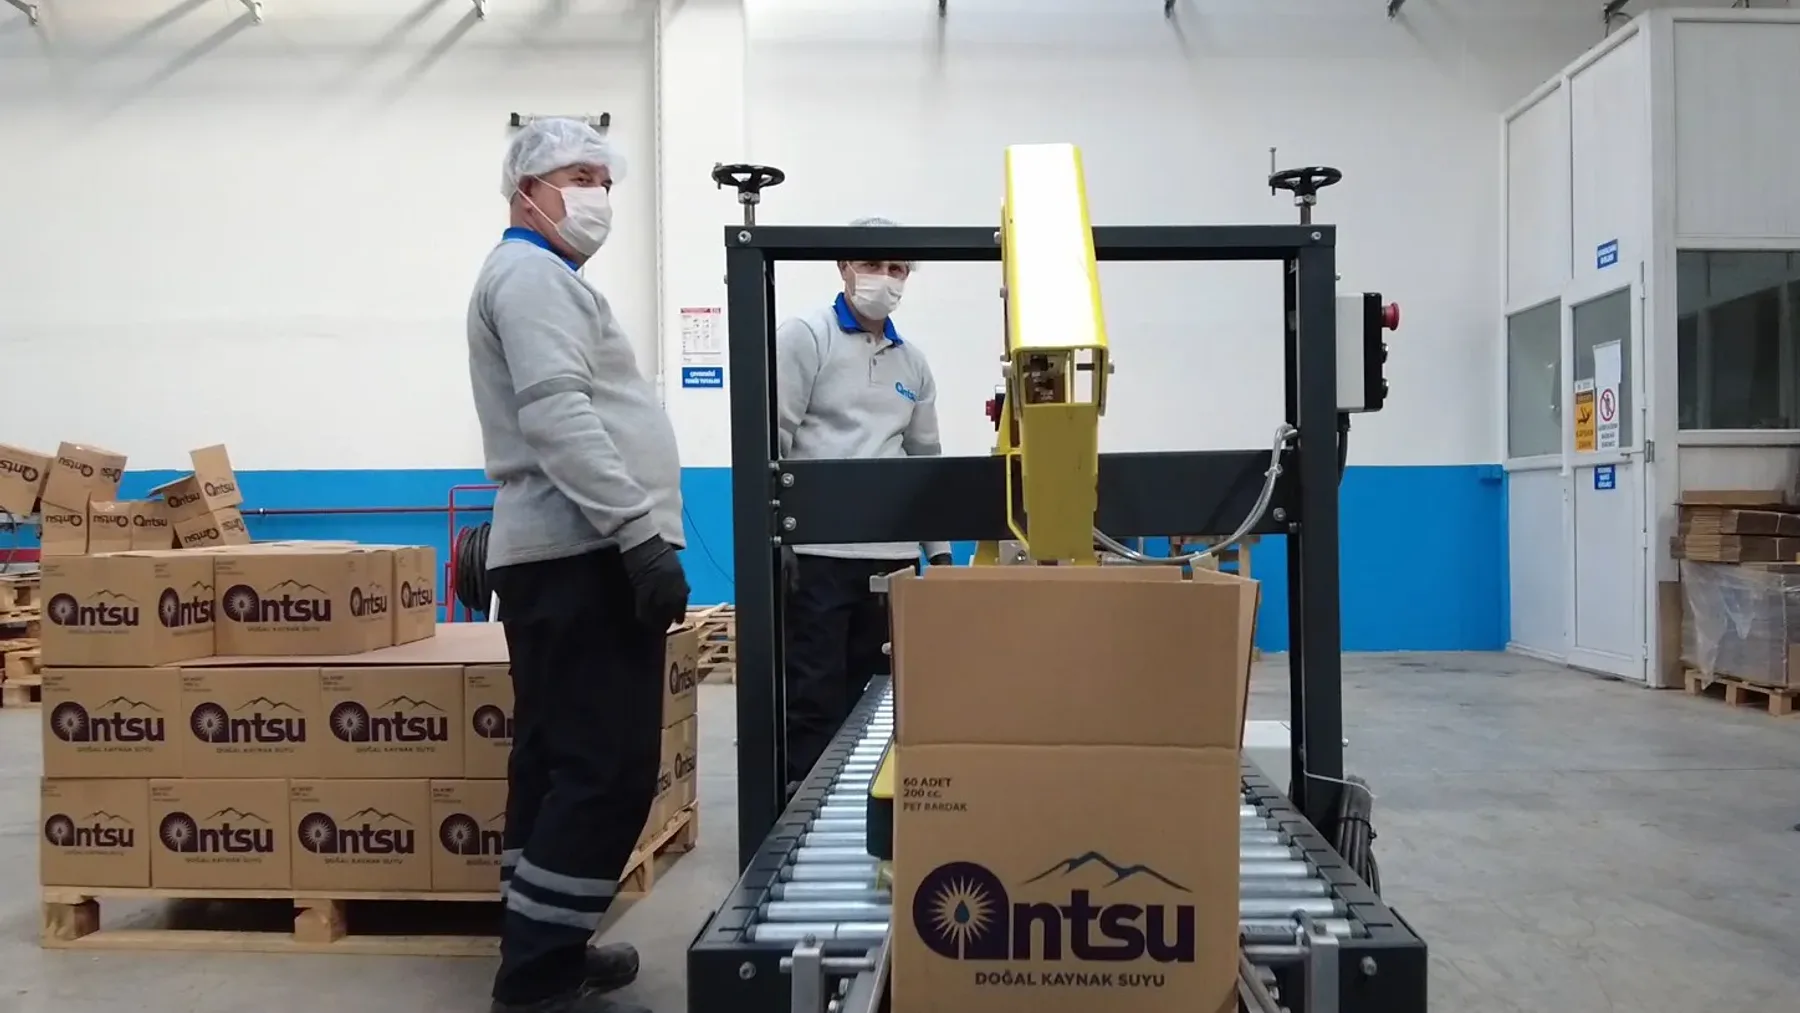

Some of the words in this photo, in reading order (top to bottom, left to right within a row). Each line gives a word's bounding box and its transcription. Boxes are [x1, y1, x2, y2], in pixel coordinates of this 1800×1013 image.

[903, 777, 918, 787] 60
[920, 777, 951, 787] ADET
[903, 788, 925, 798] 200
[903, 802, 921, 812] PET
[924, 802, 968, 812] BARDAK
[912, 861, 1196, 962] antsu
[975, 969, 1036, 986] DOĞAL
[1041, 972, 1113, 987] KAYNAK
[1118, 973, 1165, 987] SUYU
